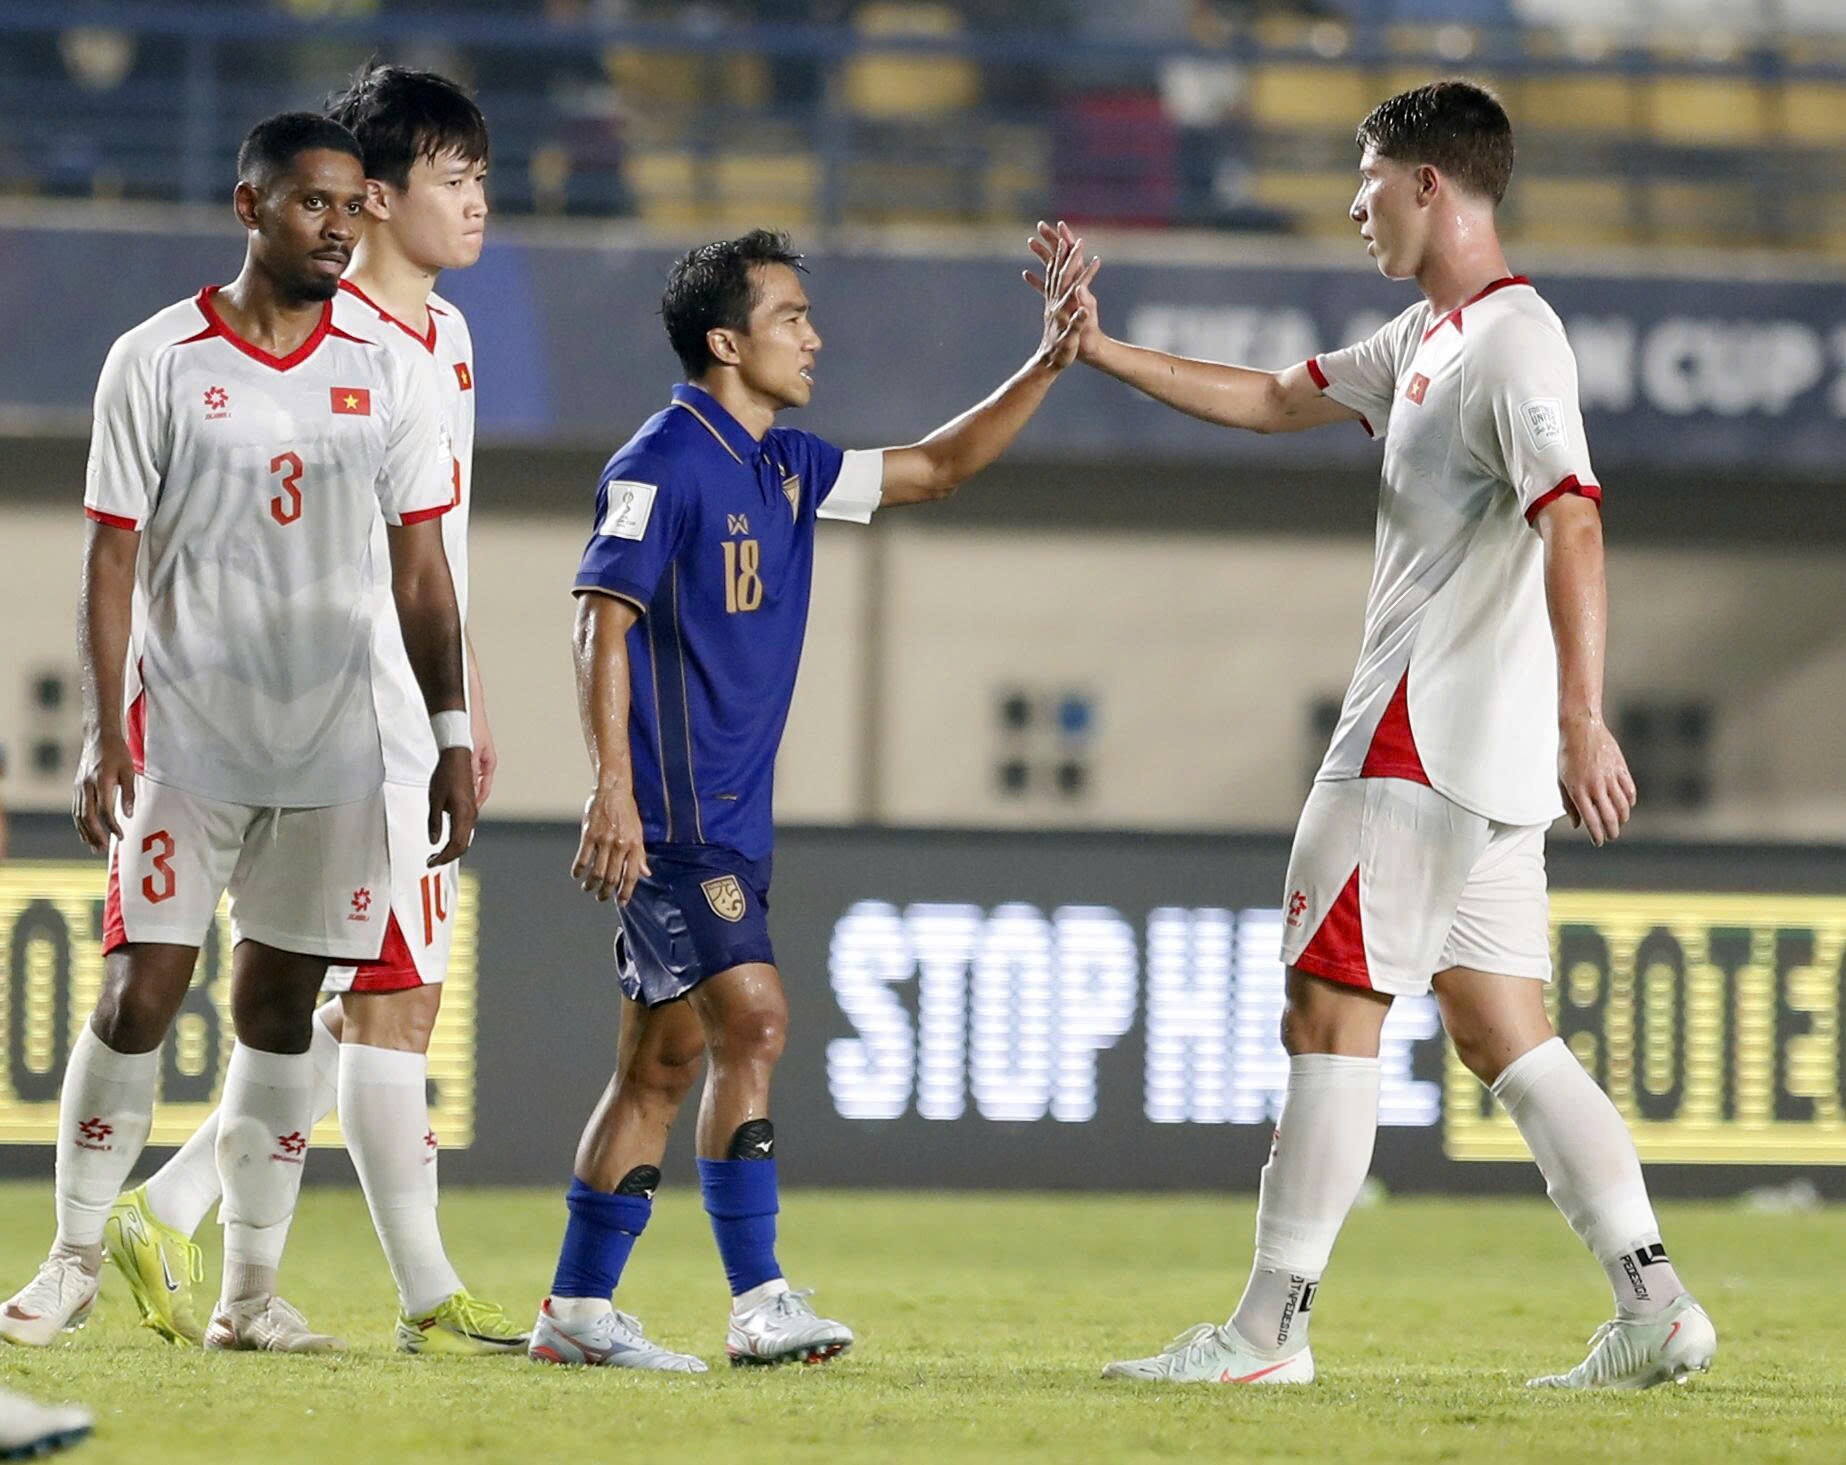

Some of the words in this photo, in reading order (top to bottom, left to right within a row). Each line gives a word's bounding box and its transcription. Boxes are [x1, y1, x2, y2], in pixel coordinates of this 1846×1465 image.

[1641, 318, 1824, 416] CUP
[270, 451, 303, 526] 3
[720, 539, 763, 614] 18
[141, 830, 176, 904] 3
[826, 899, 1138, 1121] STOP
[1144, 906, 1442, 1126] HAE
